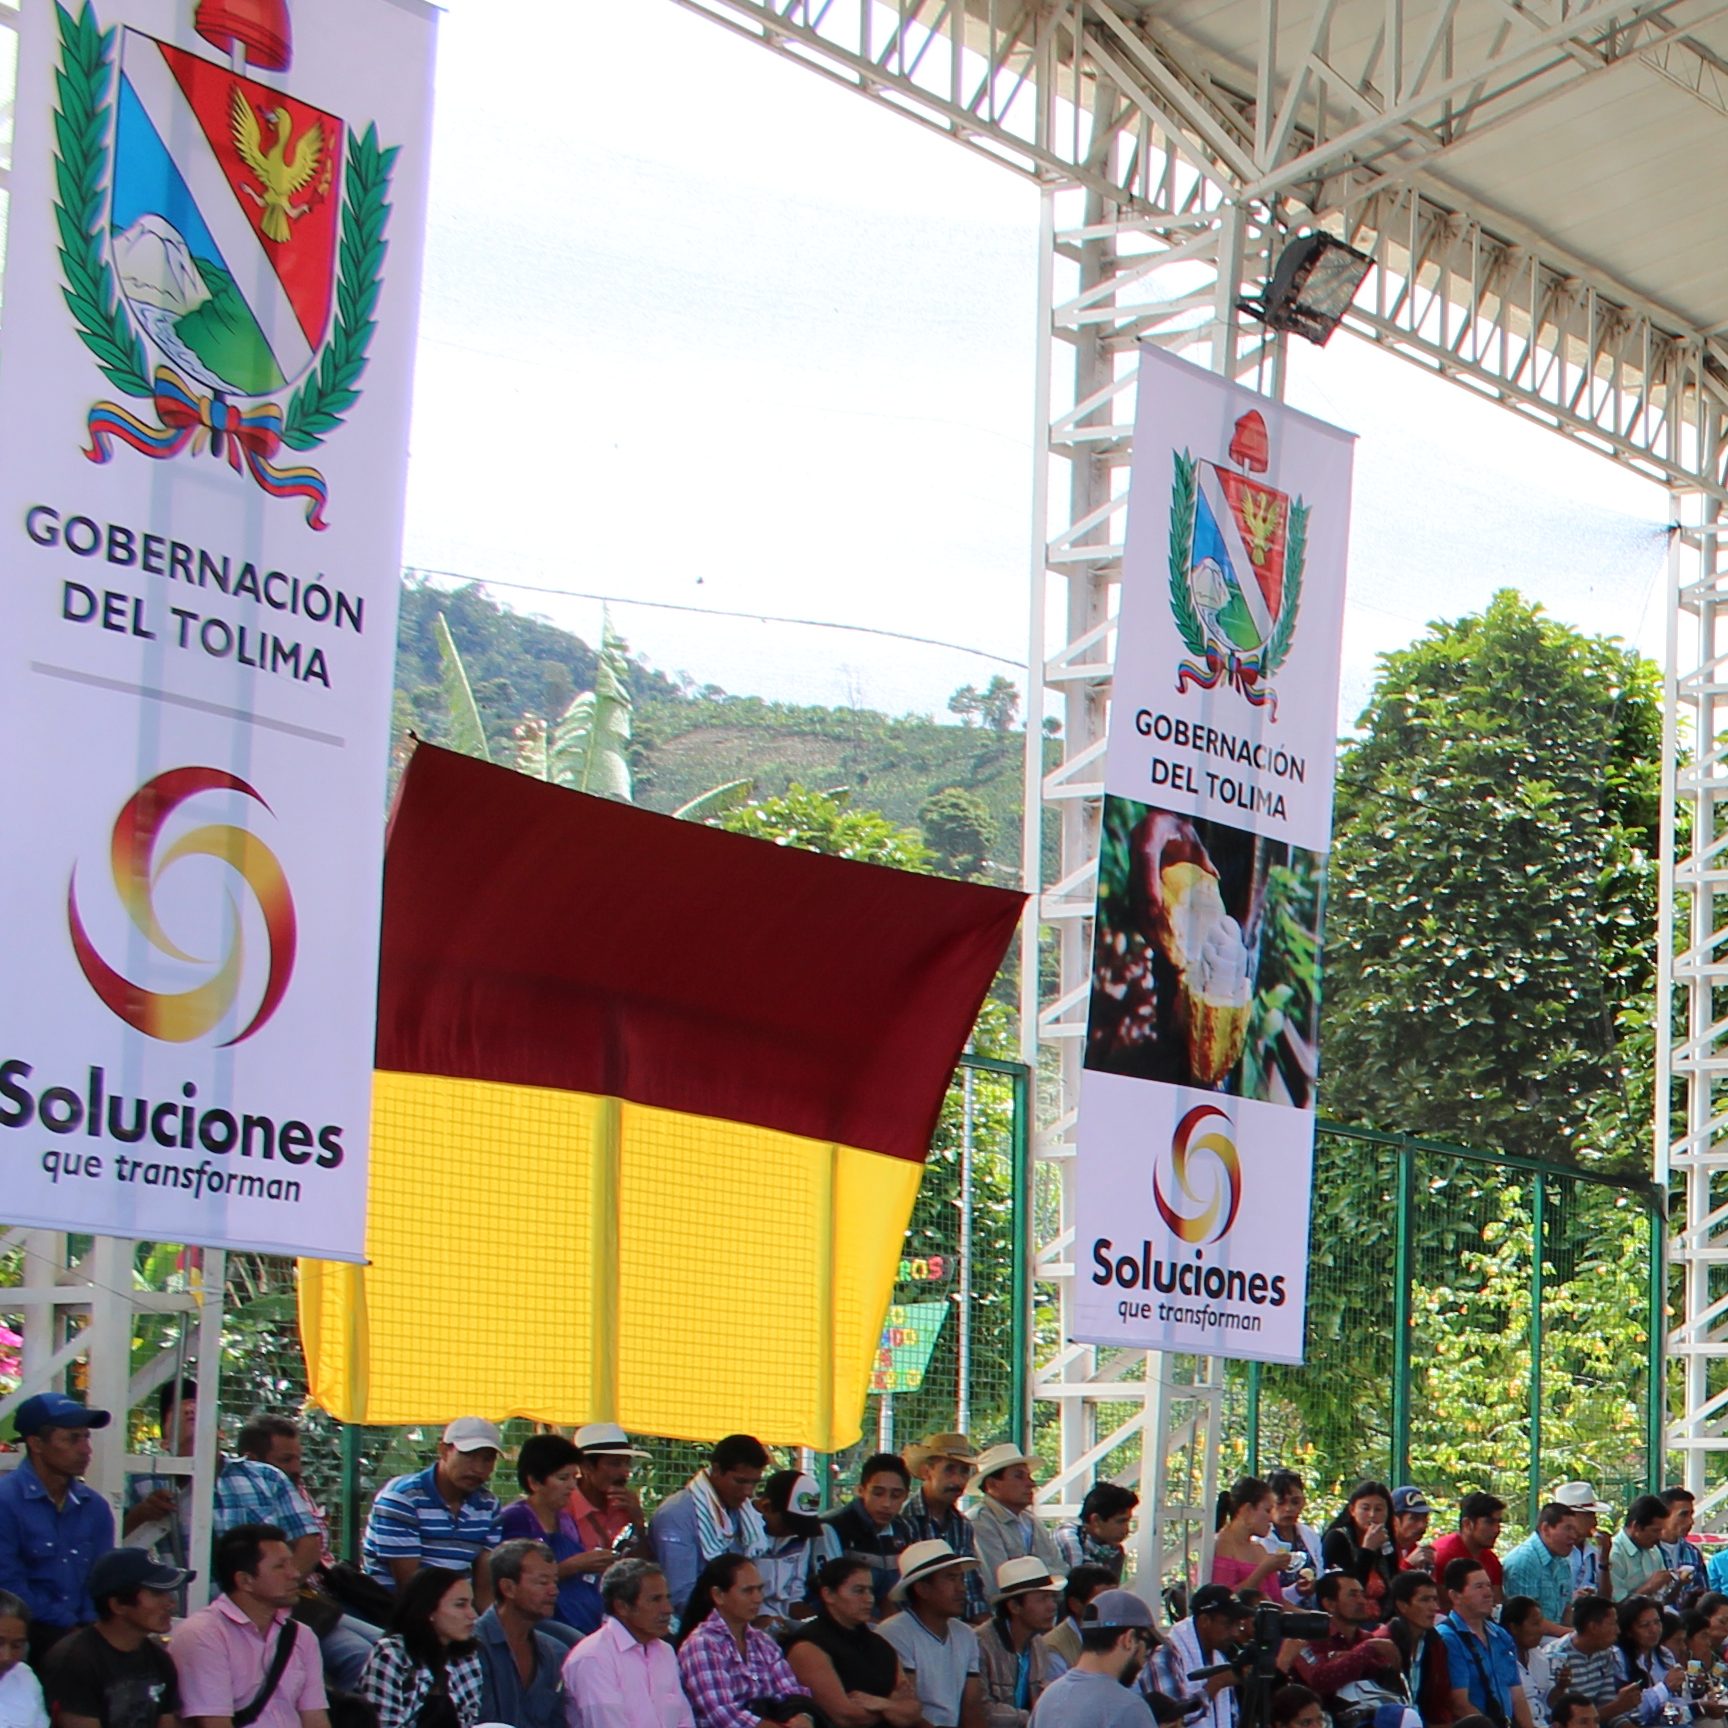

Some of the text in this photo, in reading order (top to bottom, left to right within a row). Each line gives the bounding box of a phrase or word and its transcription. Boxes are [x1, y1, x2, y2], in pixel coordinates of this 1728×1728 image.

[25, 505, 366, 635] GOBERNACIÓN
[61, 579, 332, 689] DEL TOLIMA
[1135, 708, 1305, 784] GOBERNACIÓN
[1151, 756, 1288, 822] DEL TOLIMA
[0, 1058, 346, 1170] Soluciones
[42, 1149, 302, 1203] que transforman
[1092, 1237, 1287, 1307] Soluciones
[1118, 1300, 1262, 1332] que transforman
